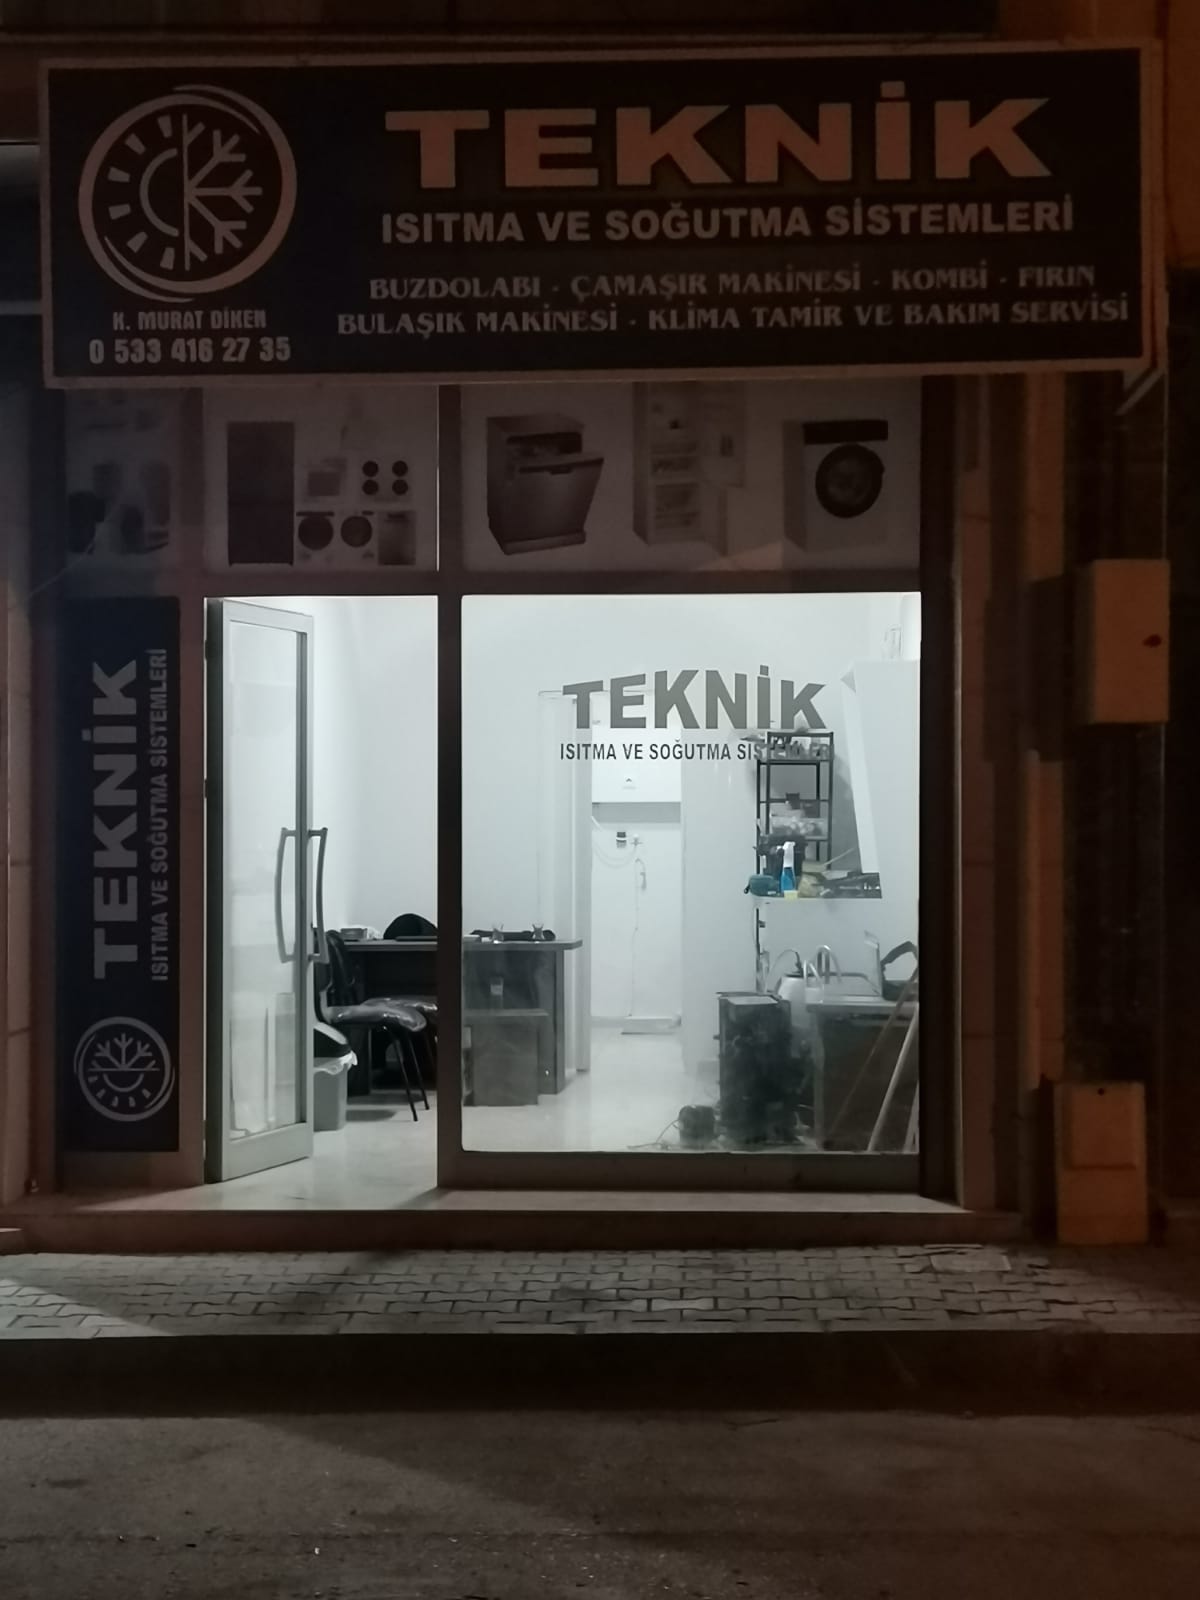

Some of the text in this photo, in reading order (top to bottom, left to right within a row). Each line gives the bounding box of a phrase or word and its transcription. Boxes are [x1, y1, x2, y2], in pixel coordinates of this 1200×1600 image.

[384, 80, 1052, 190] TEKNİK
[381, 194, 1074, 244] ISITMA VE SOĞUTMA SİSTEMLERİ
[369, 275, 541, 301] BUZDOLABI
[570, 272, 707, 303] ÇAMAŞIR
[718, 261, 862, 296] MAKİNESİ
[891, 259, 988, 291] KOMBİ
[1018, 265, 1096, 289] FIRIN
[112, 312, 131, 331] K.
[138, 309, 203, 330] MURAT
[337, 311, 466, 341] BULAŞIK
[476, 302, 618, 333] MAKİNESİ
[648, 299, 741, 332] KLİMA
[751, 297, 844, 328] TAMİR
[854, 303, 893, 326] VE
[904, 300, 1000, 325] BAKIM
[1010, 291, 1129, 323] SERVİSİ
[89, 336, 292, 364] 0 533 416 27 35
[562, 664, 827, 729] TEKNİK
[560, 743, 617, 760] ISITMA
[622, 743, 643, 760] VE
[649, 738, 731, 760] SOĞUTMA
[82, 659, 138, 980] TEKNİK
[144, 648, 169, 982] ISITMA VE SOĞUTMA SİSTEMLERİ
